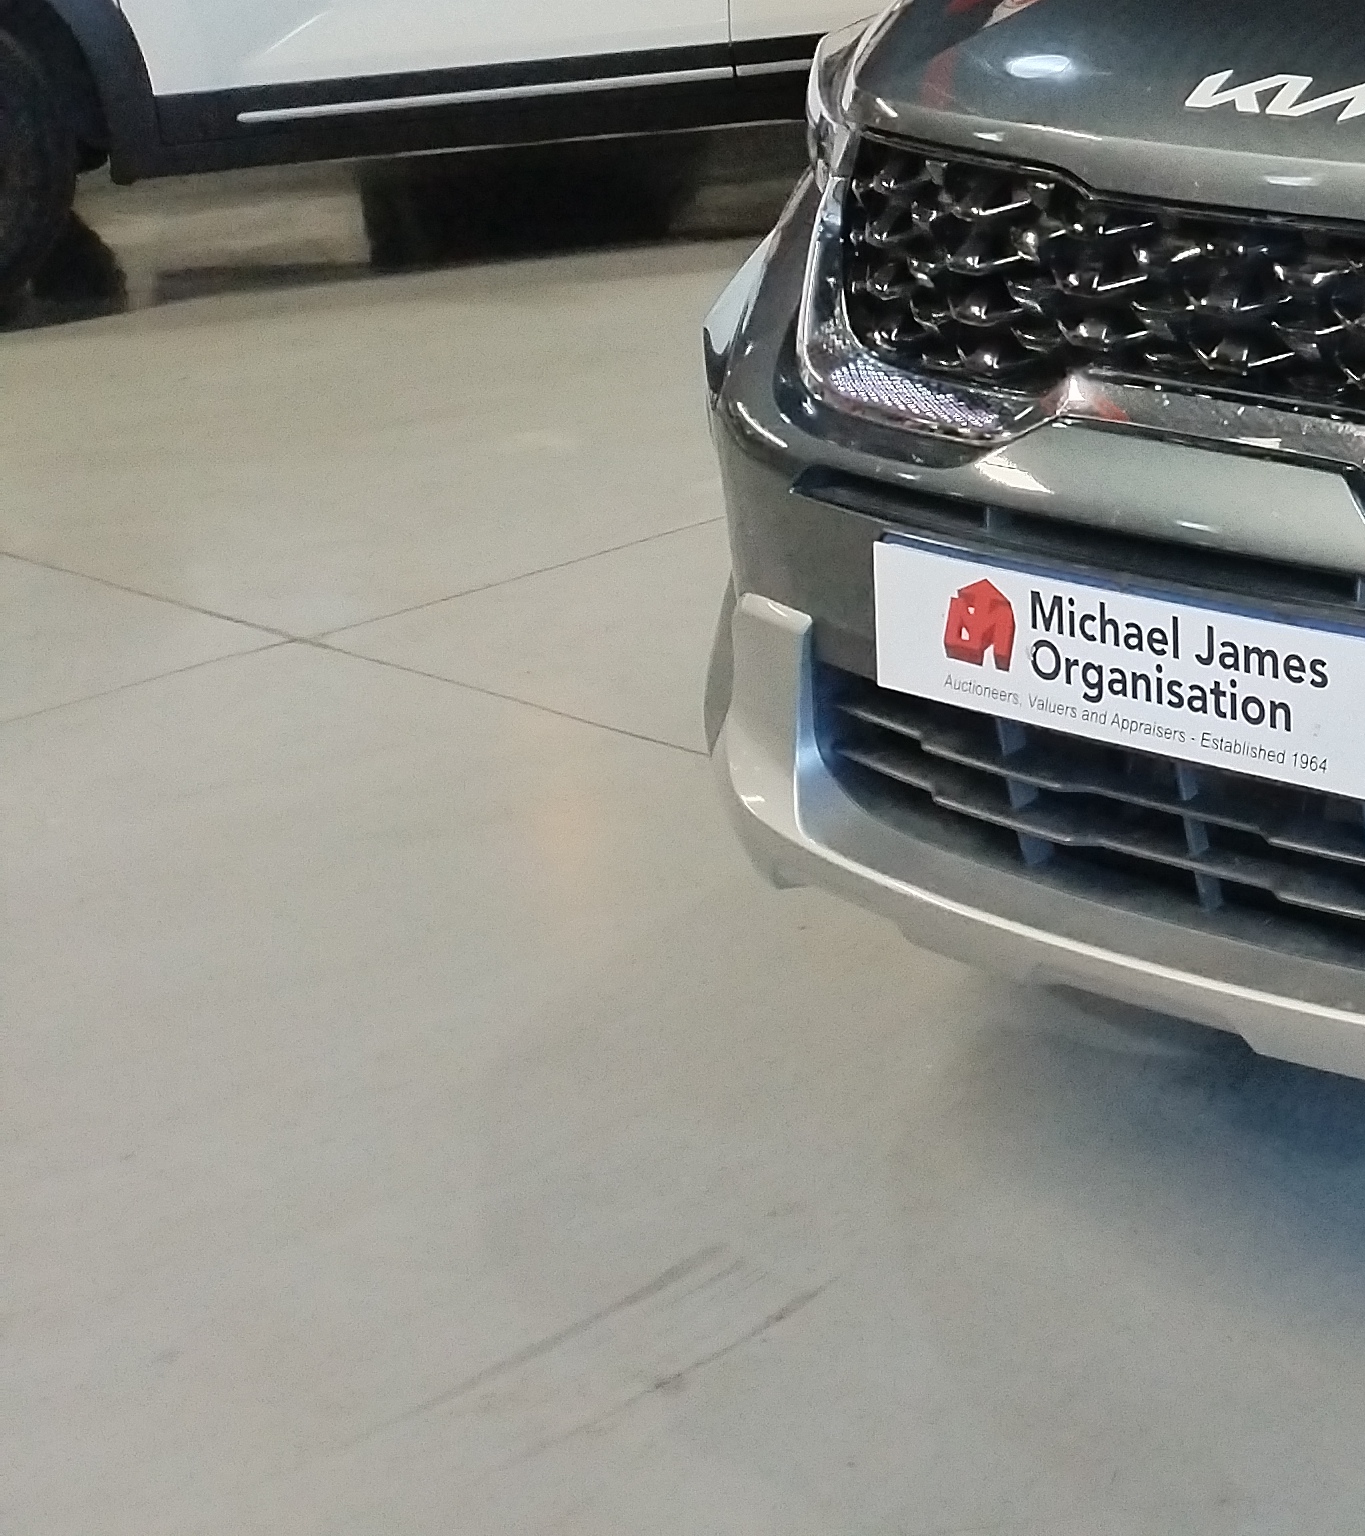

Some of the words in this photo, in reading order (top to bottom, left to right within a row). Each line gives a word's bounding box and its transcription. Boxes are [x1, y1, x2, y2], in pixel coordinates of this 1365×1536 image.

[1029, 590, 1181, 660] Michael
[1194, 624, 1330, 689] James
[1030, 638, 1293, 733] Organisation
[943, 673, 1023, 708] Auctioneers,
[1028, 693, 1078, 720] Valuers
[1081, 707, 1108, 726] and
[1110, 712, 1186, 744] Appraisers
[1200, 731, 1287, 766] Established
[1291, 751, 1329, 775] 1964
